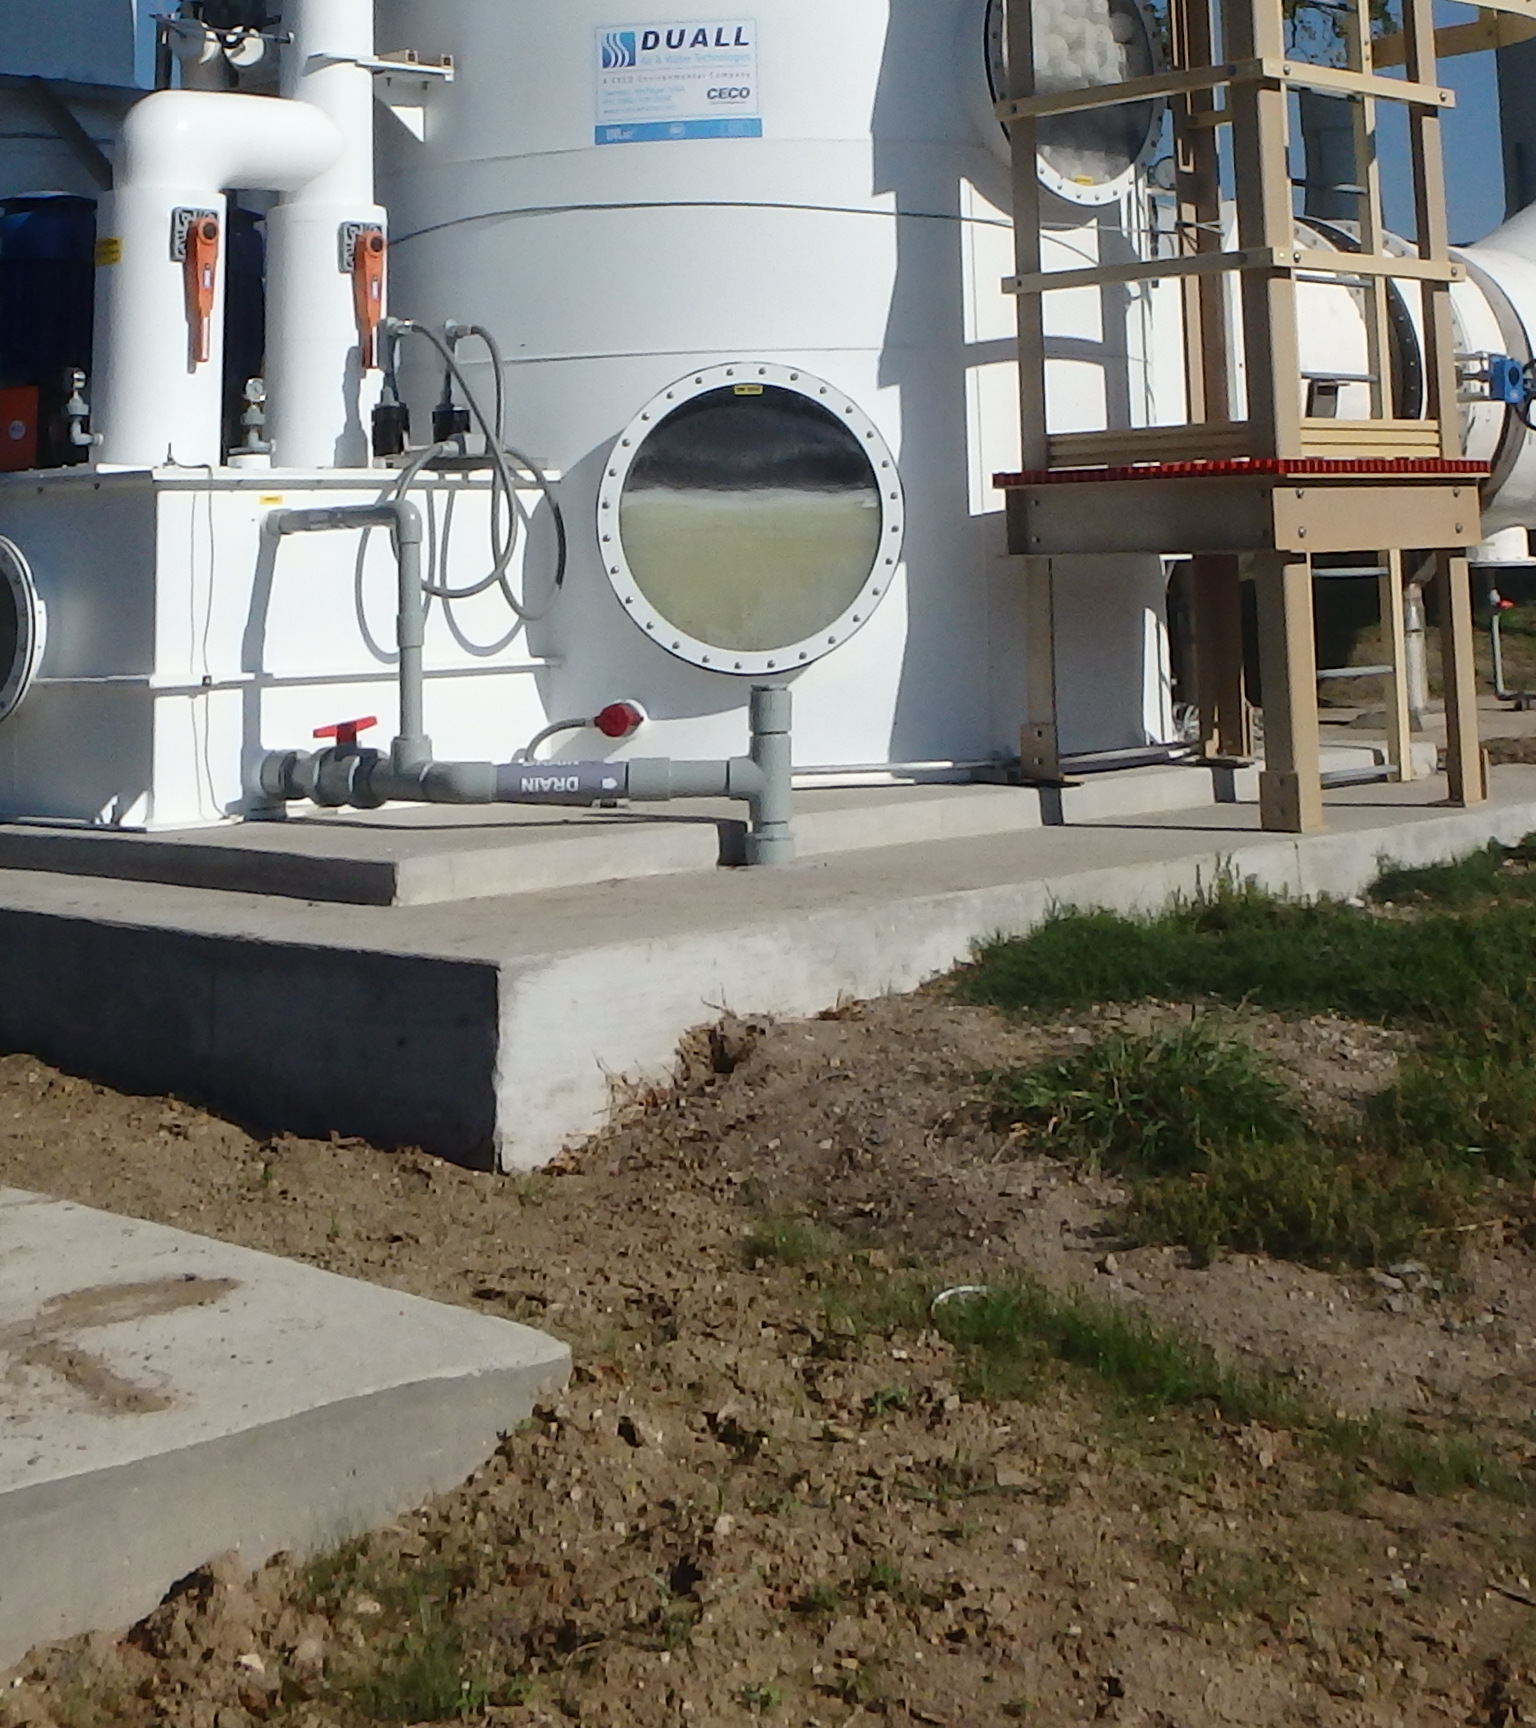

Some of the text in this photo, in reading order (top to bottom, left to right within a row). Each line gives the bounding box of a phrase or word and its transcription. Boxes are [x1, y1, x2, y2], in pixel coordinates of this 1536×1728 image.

[642, 26, 749, 51] DUALL
[707, 87, 750, 100] CECO
[521, 776, 579, 793] DRAIN
